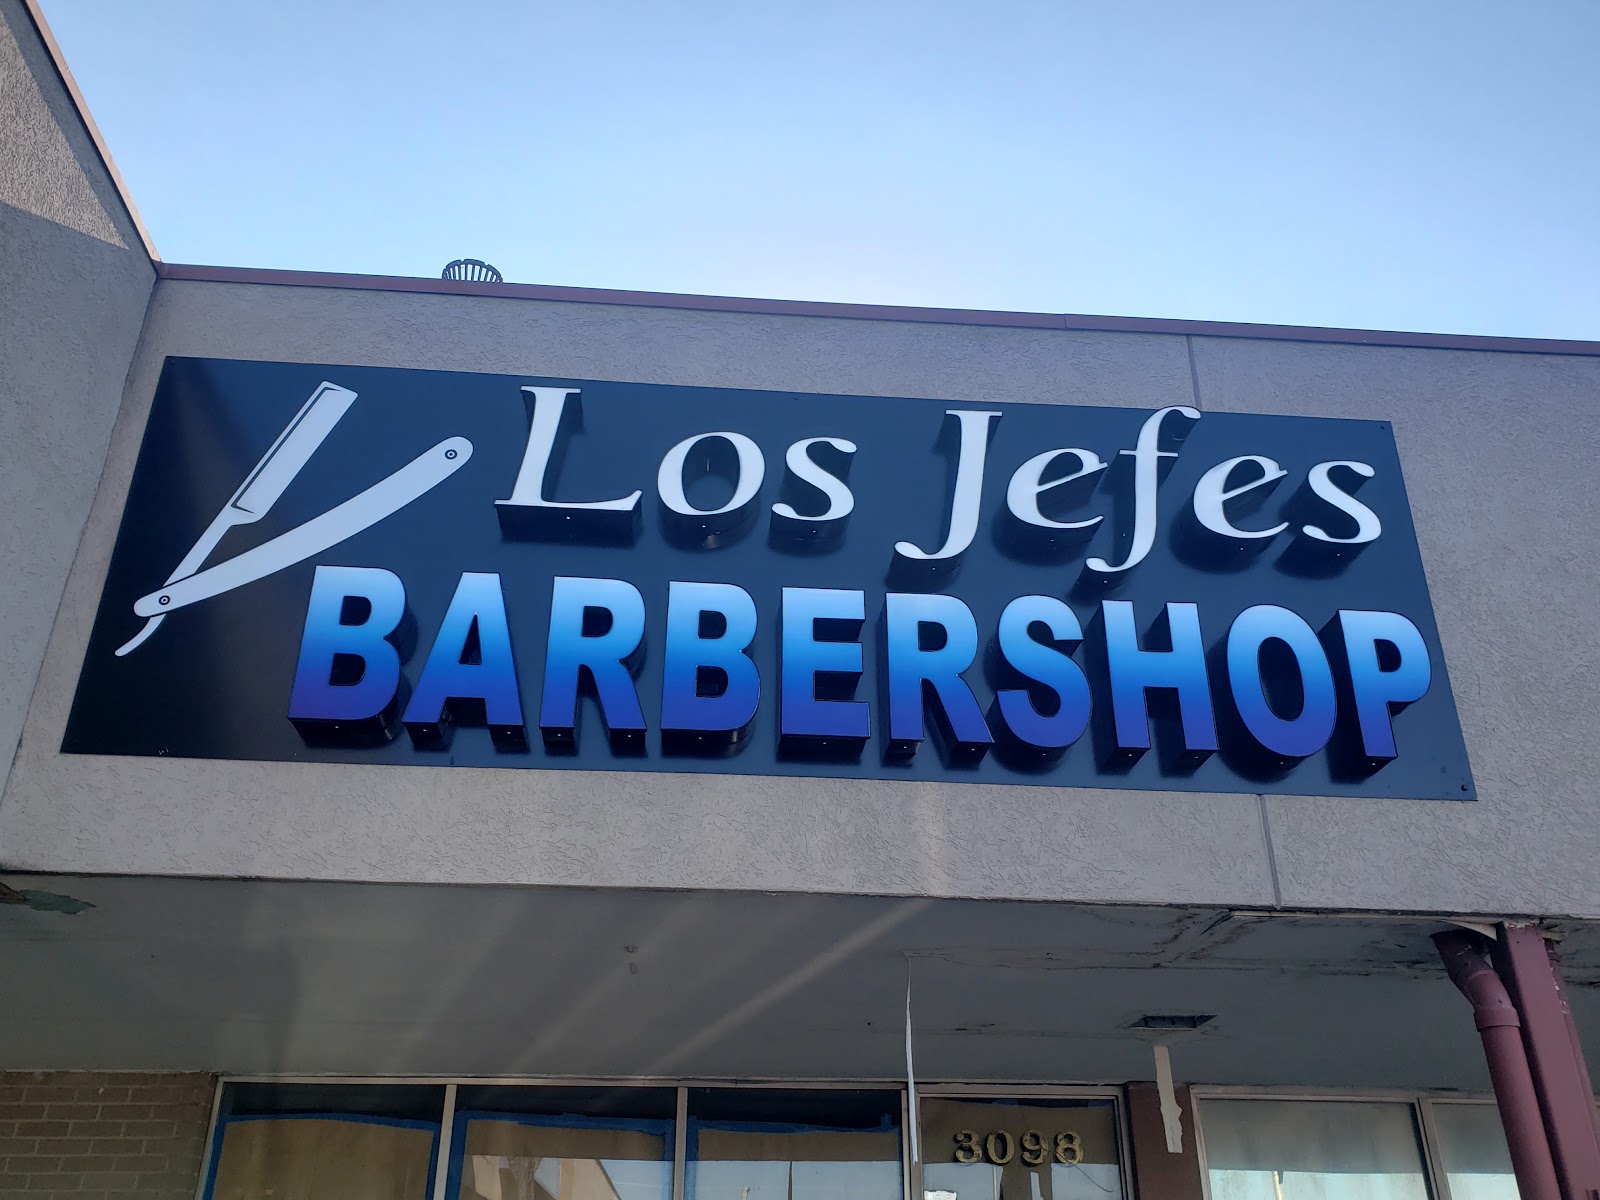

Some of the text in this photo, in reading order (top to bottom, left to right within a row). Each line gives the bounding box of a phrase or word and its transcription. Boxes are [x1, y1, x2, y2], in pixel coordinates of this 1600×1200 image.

[494, 385, 1382, 573] Los Jefes
[287, 565, 1432, 760] BARBERSHOP
[954, 1129, 1083, 1165] 3098
